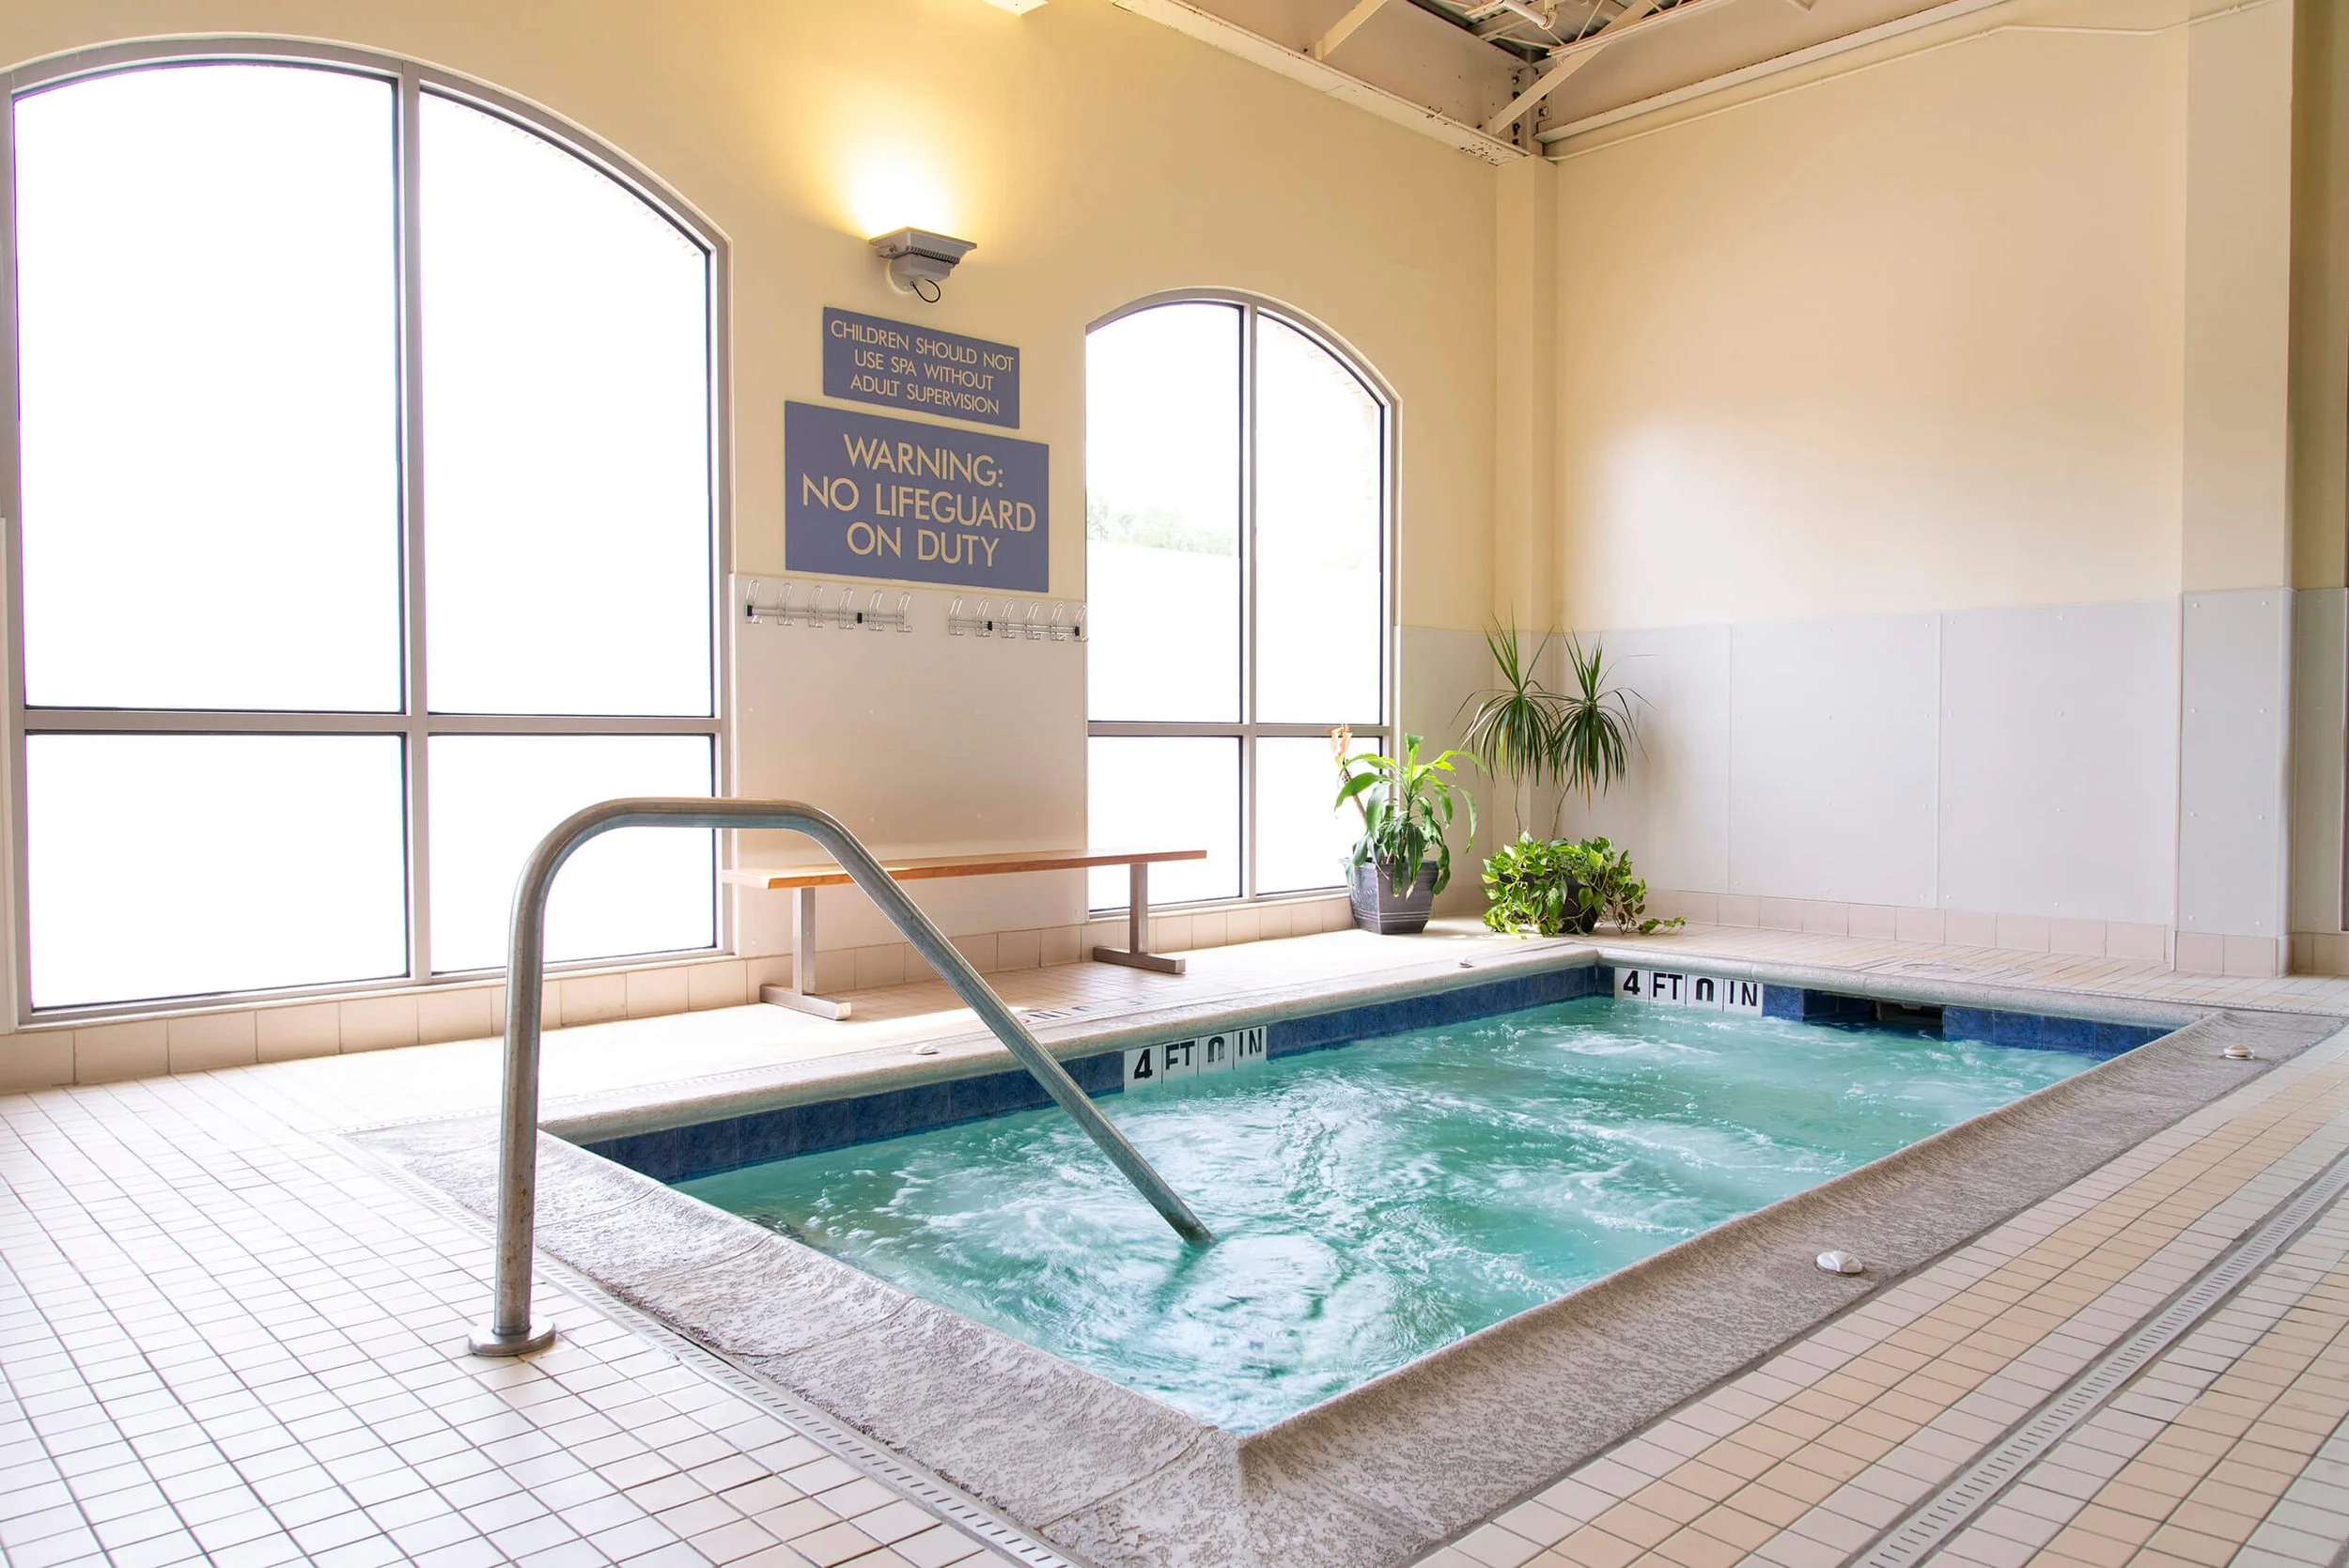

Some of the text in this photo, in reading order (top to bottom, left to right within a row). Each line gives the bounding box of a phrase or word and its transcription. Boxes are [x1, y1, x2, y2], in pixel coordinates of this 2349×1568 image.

[830, 318, 1015, 374] CHILDREN SHOULD NOT
[849, 373, 1001, 414] ADULT SUPERVISION
[854, 349, 994, 392] USE SPA WITHOUT
[843, 434, 1004, 489] WARNING:
[801, 473, 1037, 534] NO LIFEGUARD
[847, 521, 1000, 567] ON DUTY
[1623, 970, 1641, 996] 4
[1653, 972, 1683, 1001] FT
[1729, 980, 1758, 1007] IN
[1133, 1048, 1153, 1079] 4
[1165, 1040, 1196, 1070] FT
[1237, 1028, 1263, 1058] IN
